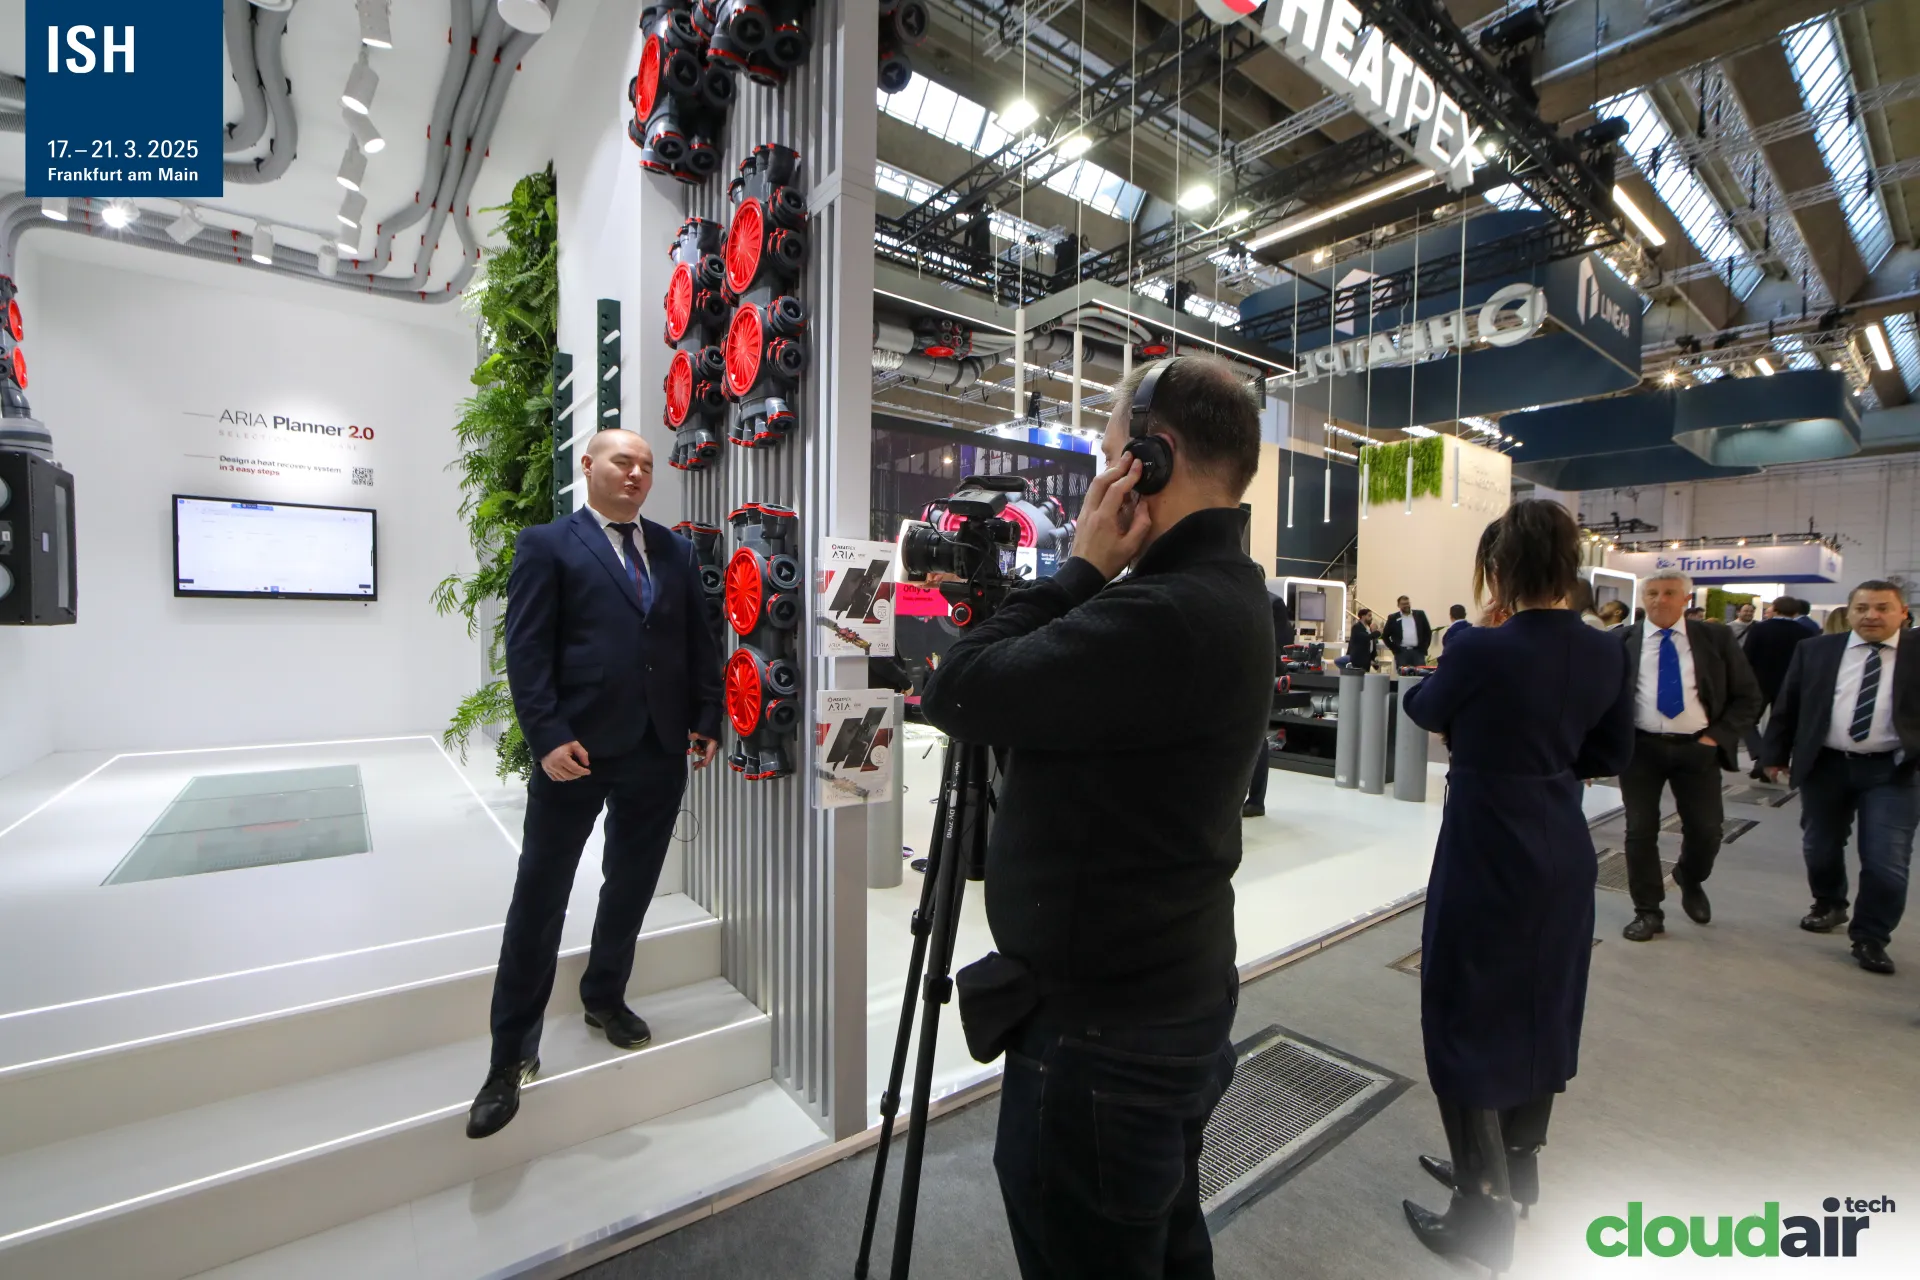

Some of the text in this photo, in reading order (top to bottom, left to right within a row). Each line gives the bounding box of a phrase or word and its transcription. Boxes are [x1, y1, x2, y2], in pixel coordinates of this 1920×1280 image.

[219, 409, 375, 441] ARIA Planner 2.0
[219, 455, 250, 466] Design
[257, 458, 275, 468] heat
[276, 462, 312, 472] recovery
[313, 464, 342, 475] system
[235, 466, 256, 475] easy
[256, 467, 281, 477] steps
[832, 551, 856, 560] ARIA
[1677, 556, 1756, 572] Trimble
[827, 703, 851, 711] ARIA
